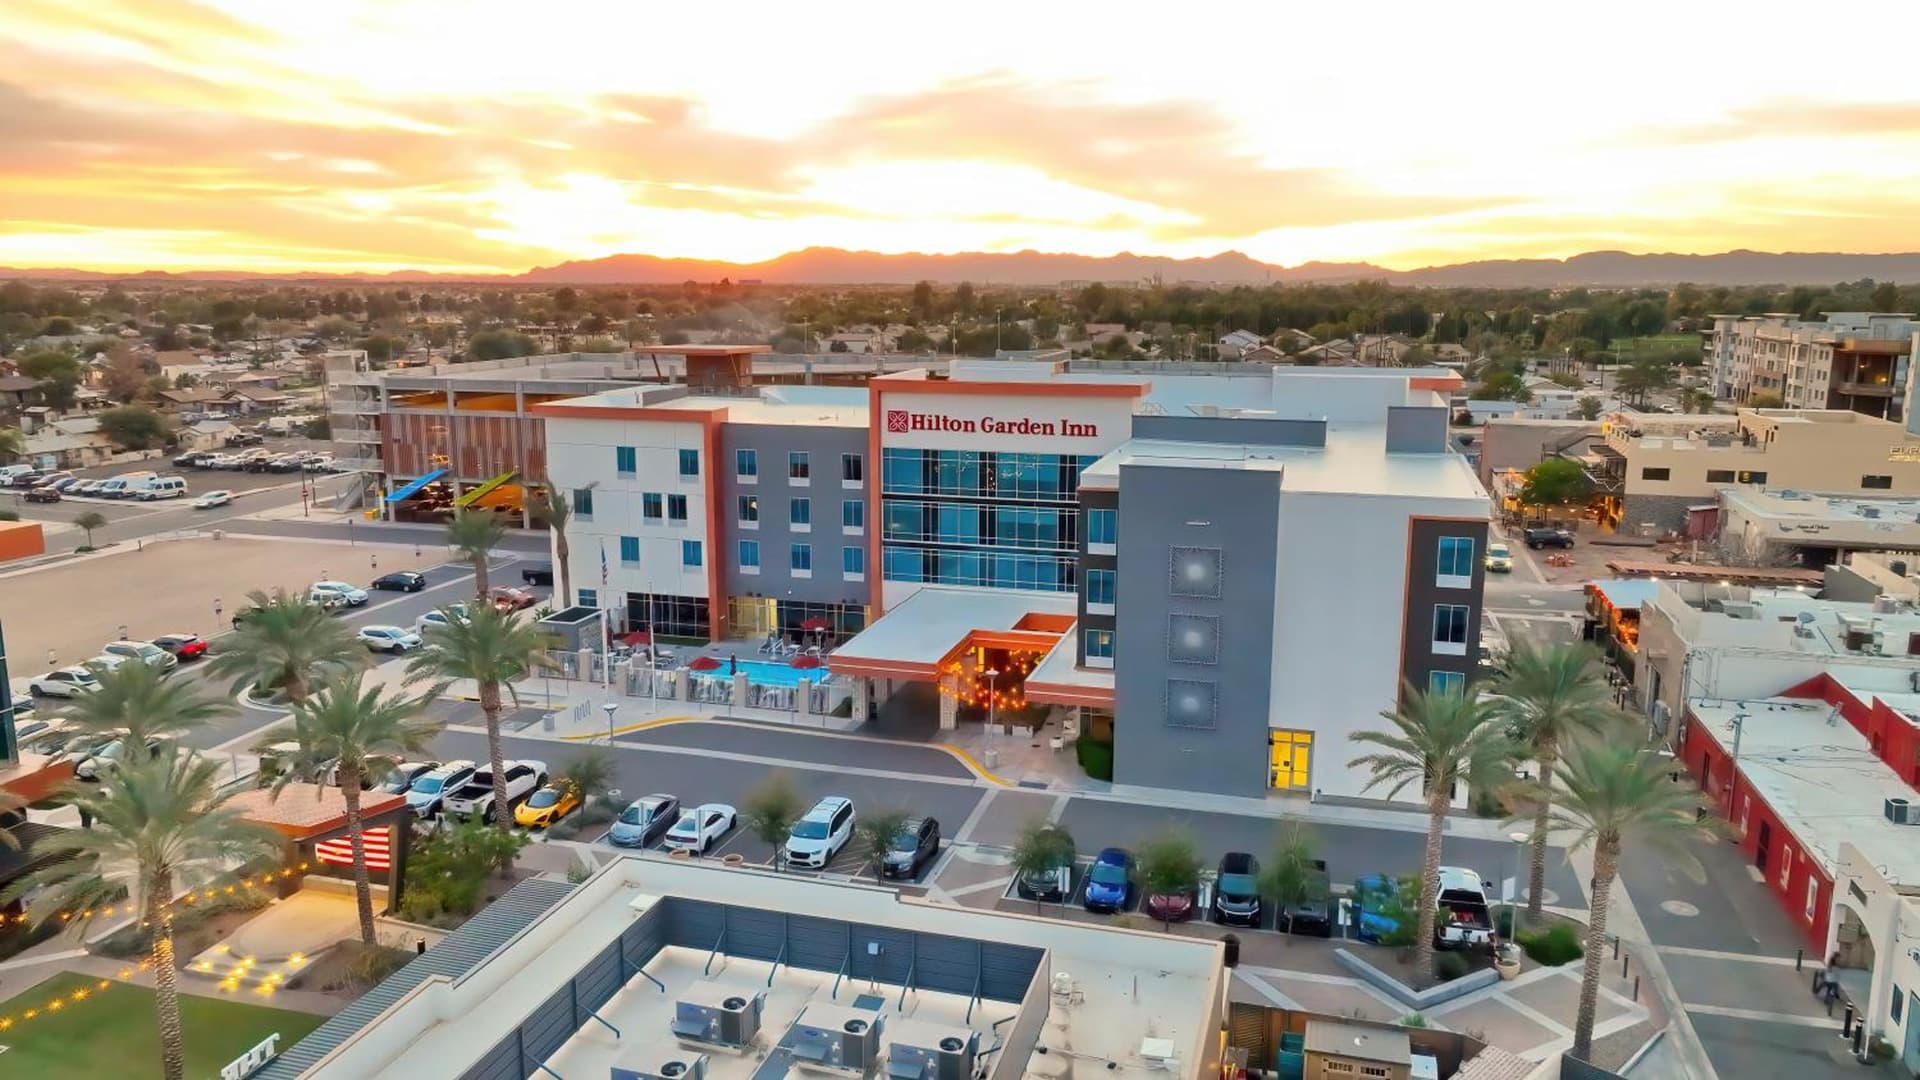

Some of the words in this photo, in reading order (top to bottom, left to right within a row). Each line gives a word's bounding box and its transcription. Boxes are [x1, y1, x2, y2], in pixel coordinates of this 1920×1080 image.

[910, 414, 976, 433] Hilton
[980, 417, 1055, 436] Garden
[1060, 419, 1098, 438] Inn
